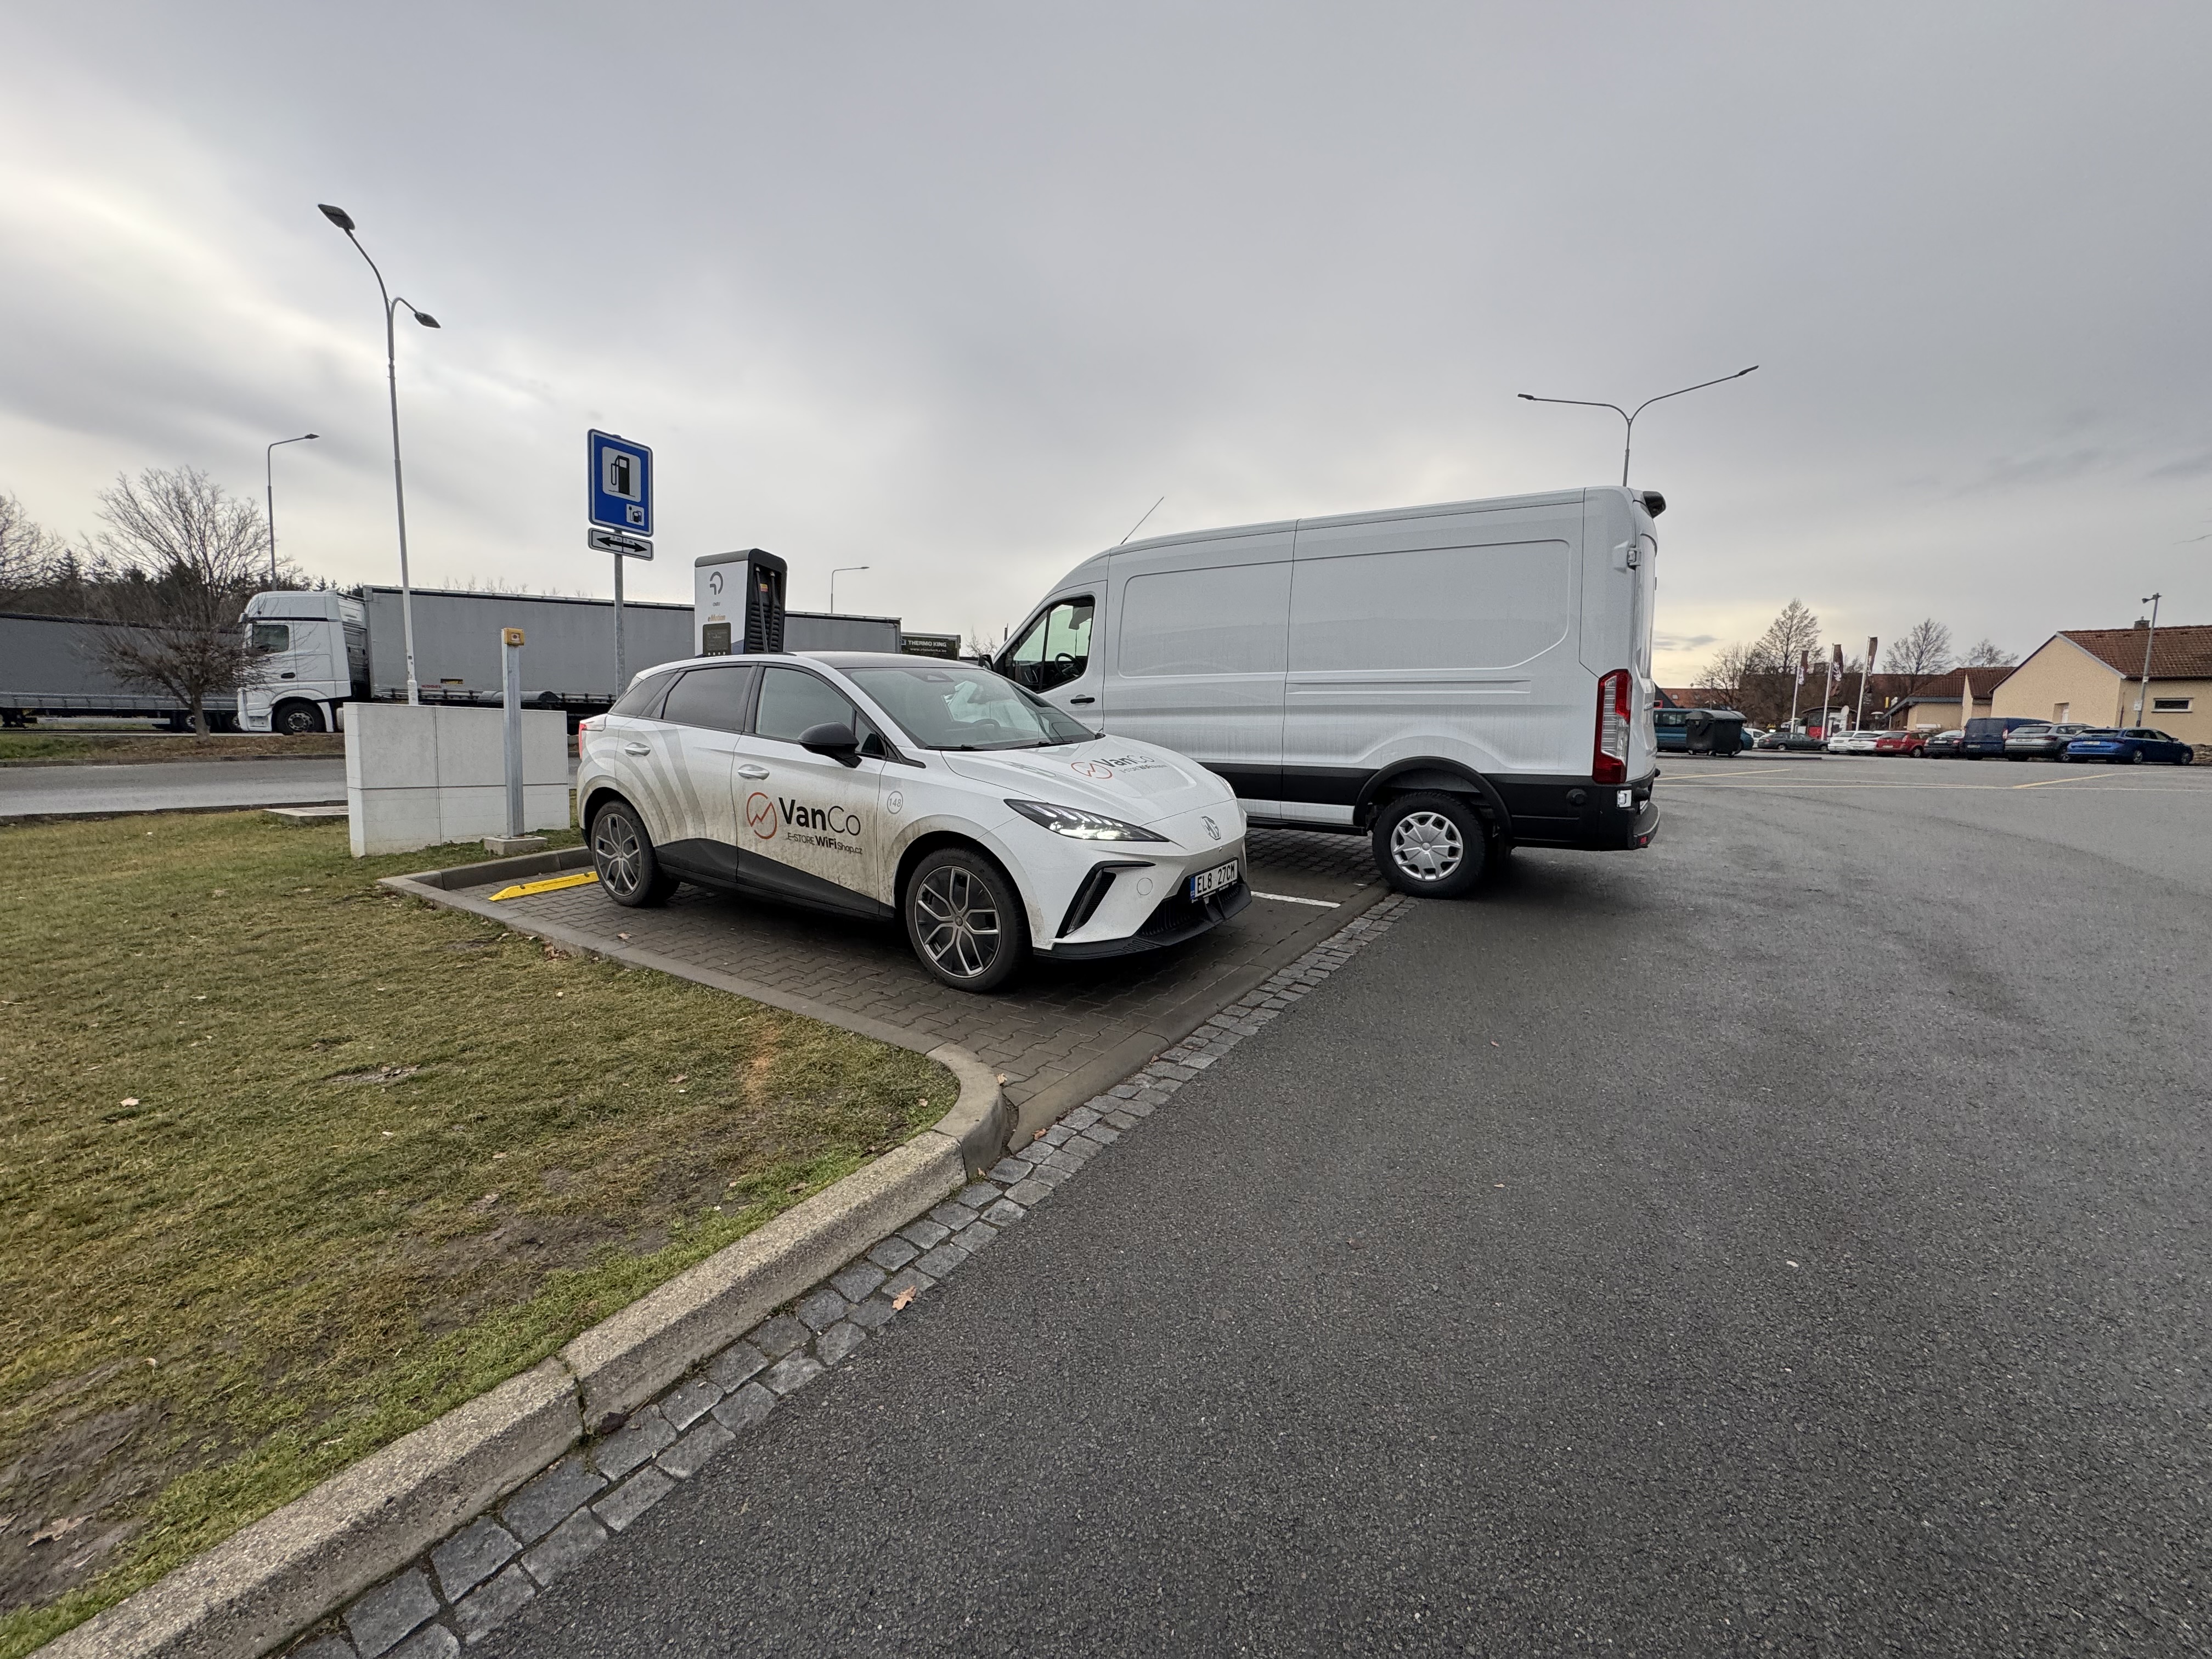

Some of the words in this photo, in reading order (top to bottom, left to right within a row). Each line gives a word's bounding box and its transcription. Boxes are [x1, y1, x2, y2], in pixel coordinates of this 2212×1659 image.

[1091, 755, 1155, 768] VanCo
[889, 798, 901, 808] 148
[778, 797, 861, 836] VanCo
[787, 832, 815, 845] E-STORE
[1197, 872, 1212, 894] EL8
